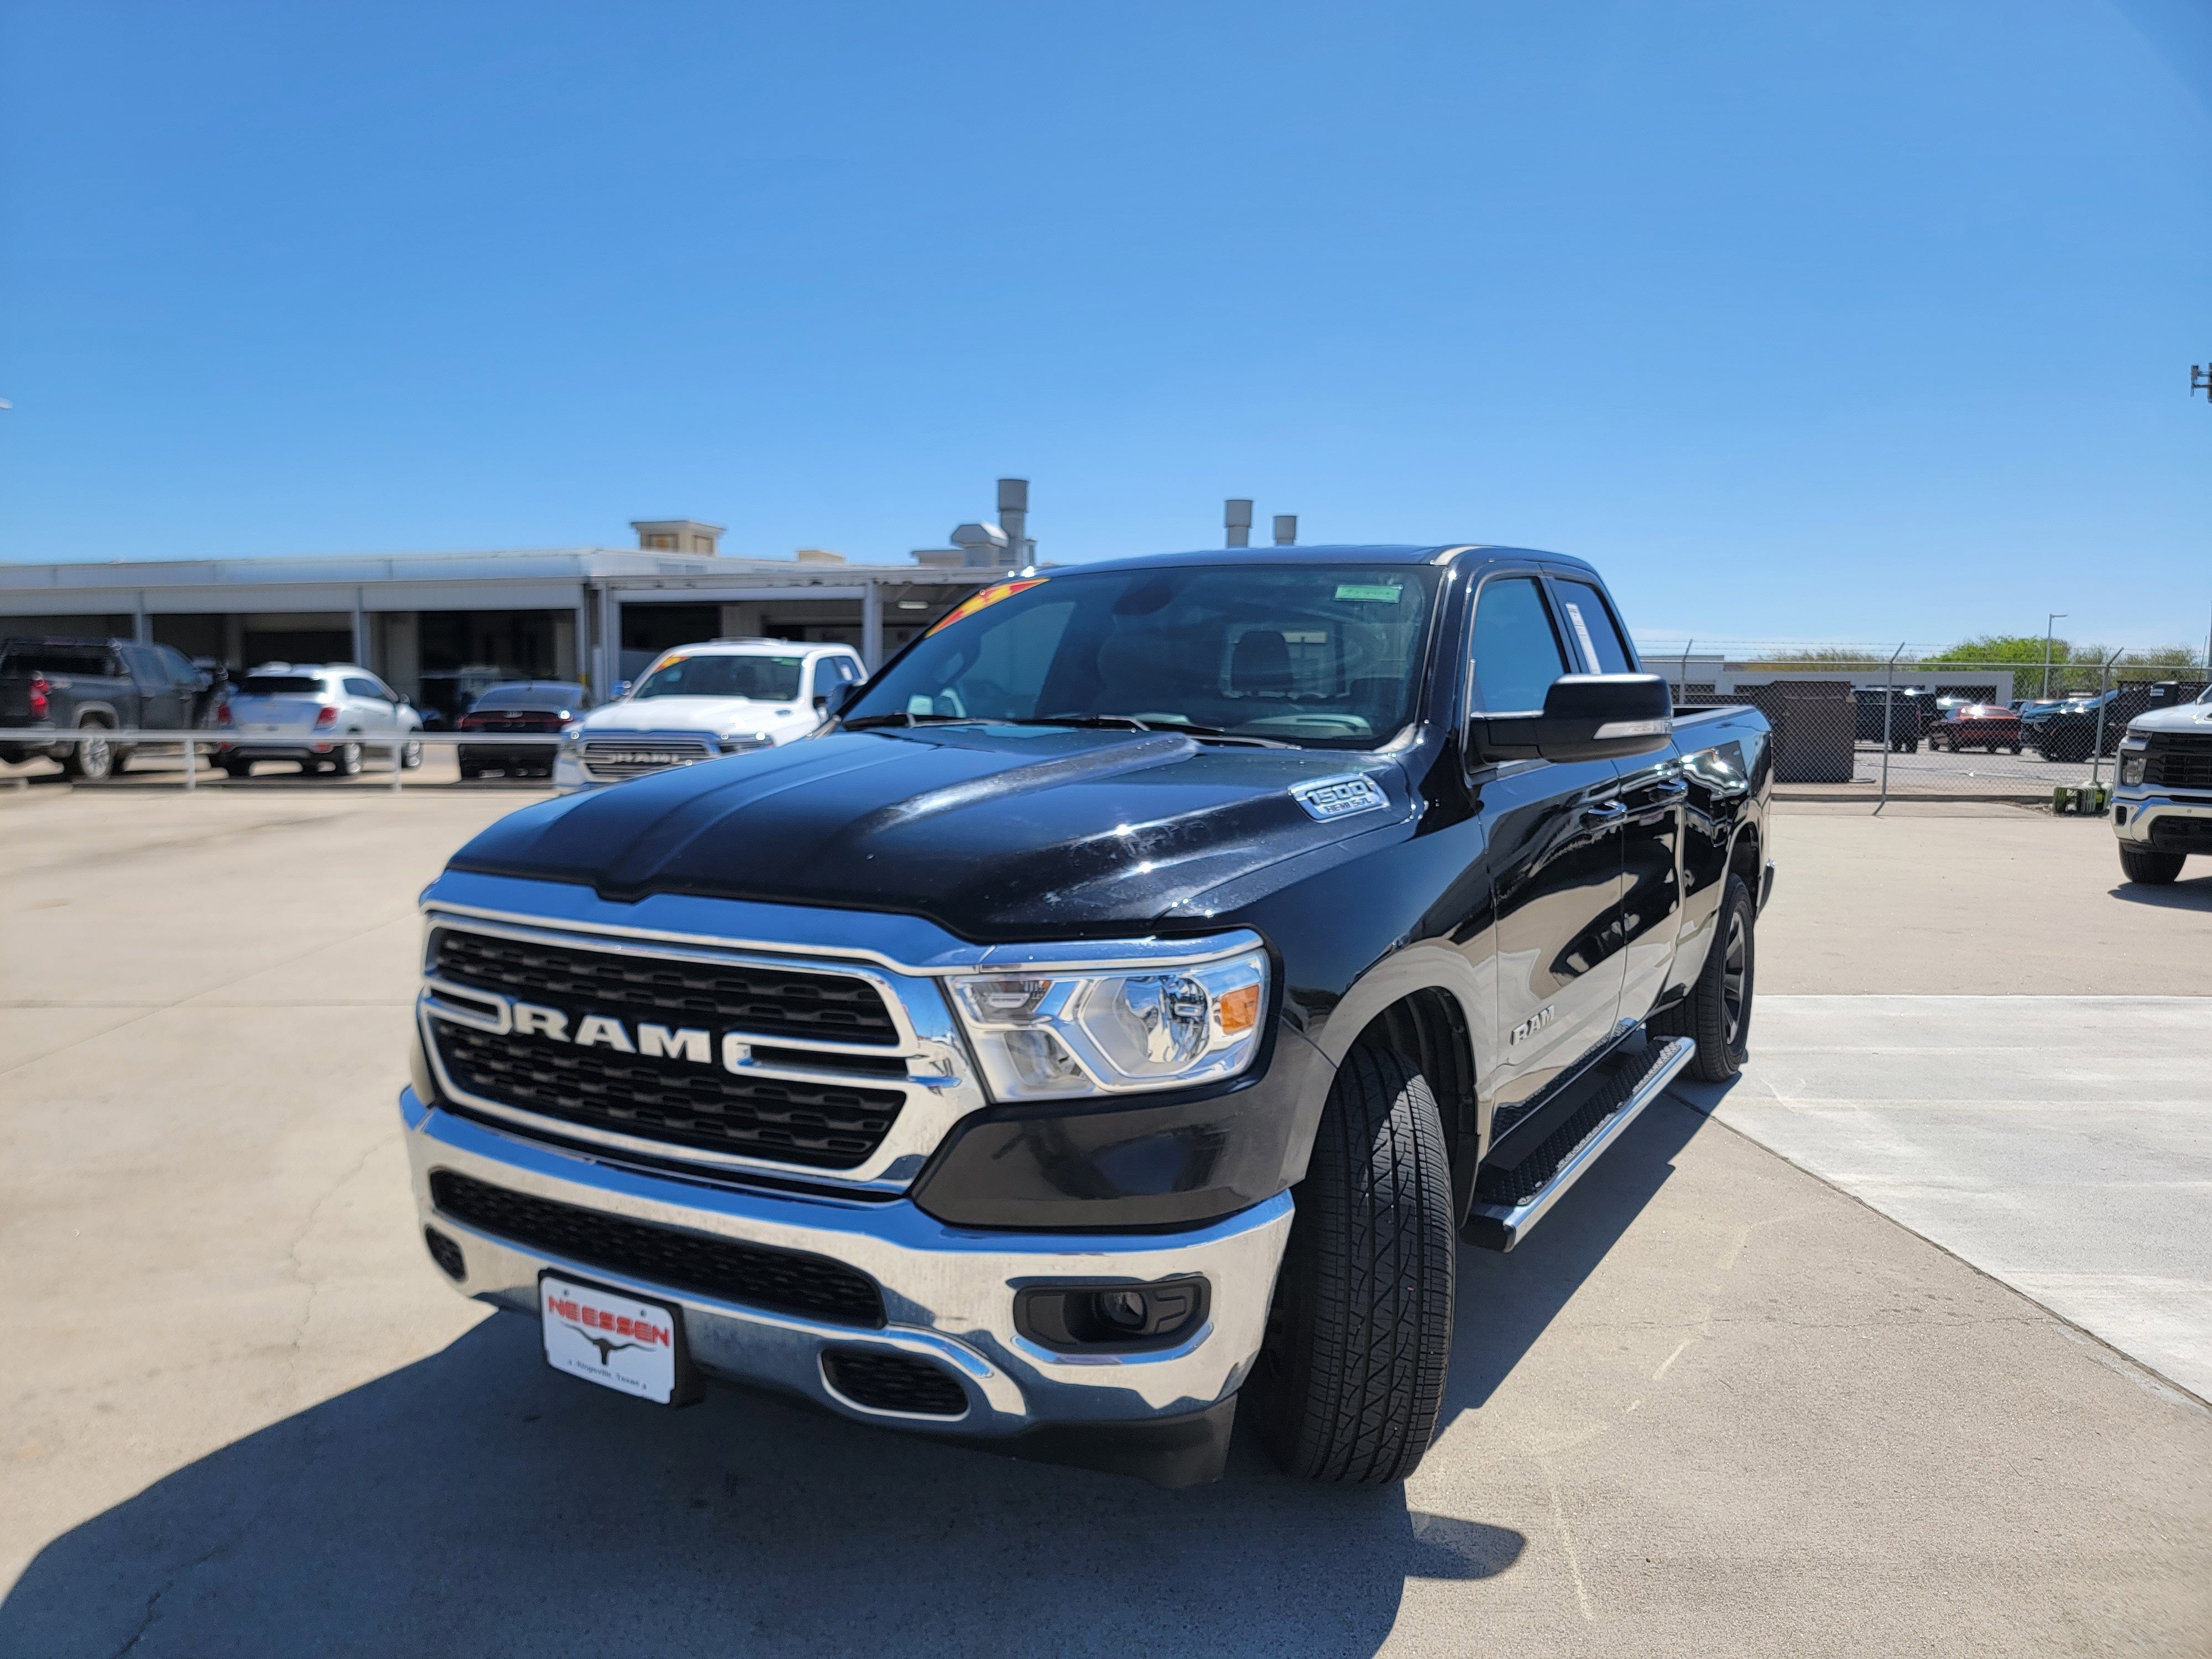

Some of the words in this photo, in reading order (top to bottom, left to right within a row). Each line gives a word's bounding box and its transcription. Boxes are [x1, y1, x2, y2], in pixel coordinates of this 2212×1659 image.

[1306, 781, 1366, 805] 1500
[514, 1003, 712, 1064] RAM
[1510, 1004, 1554, 1046] RAM
[549, 1296, 670, 1347] NEESSEN
